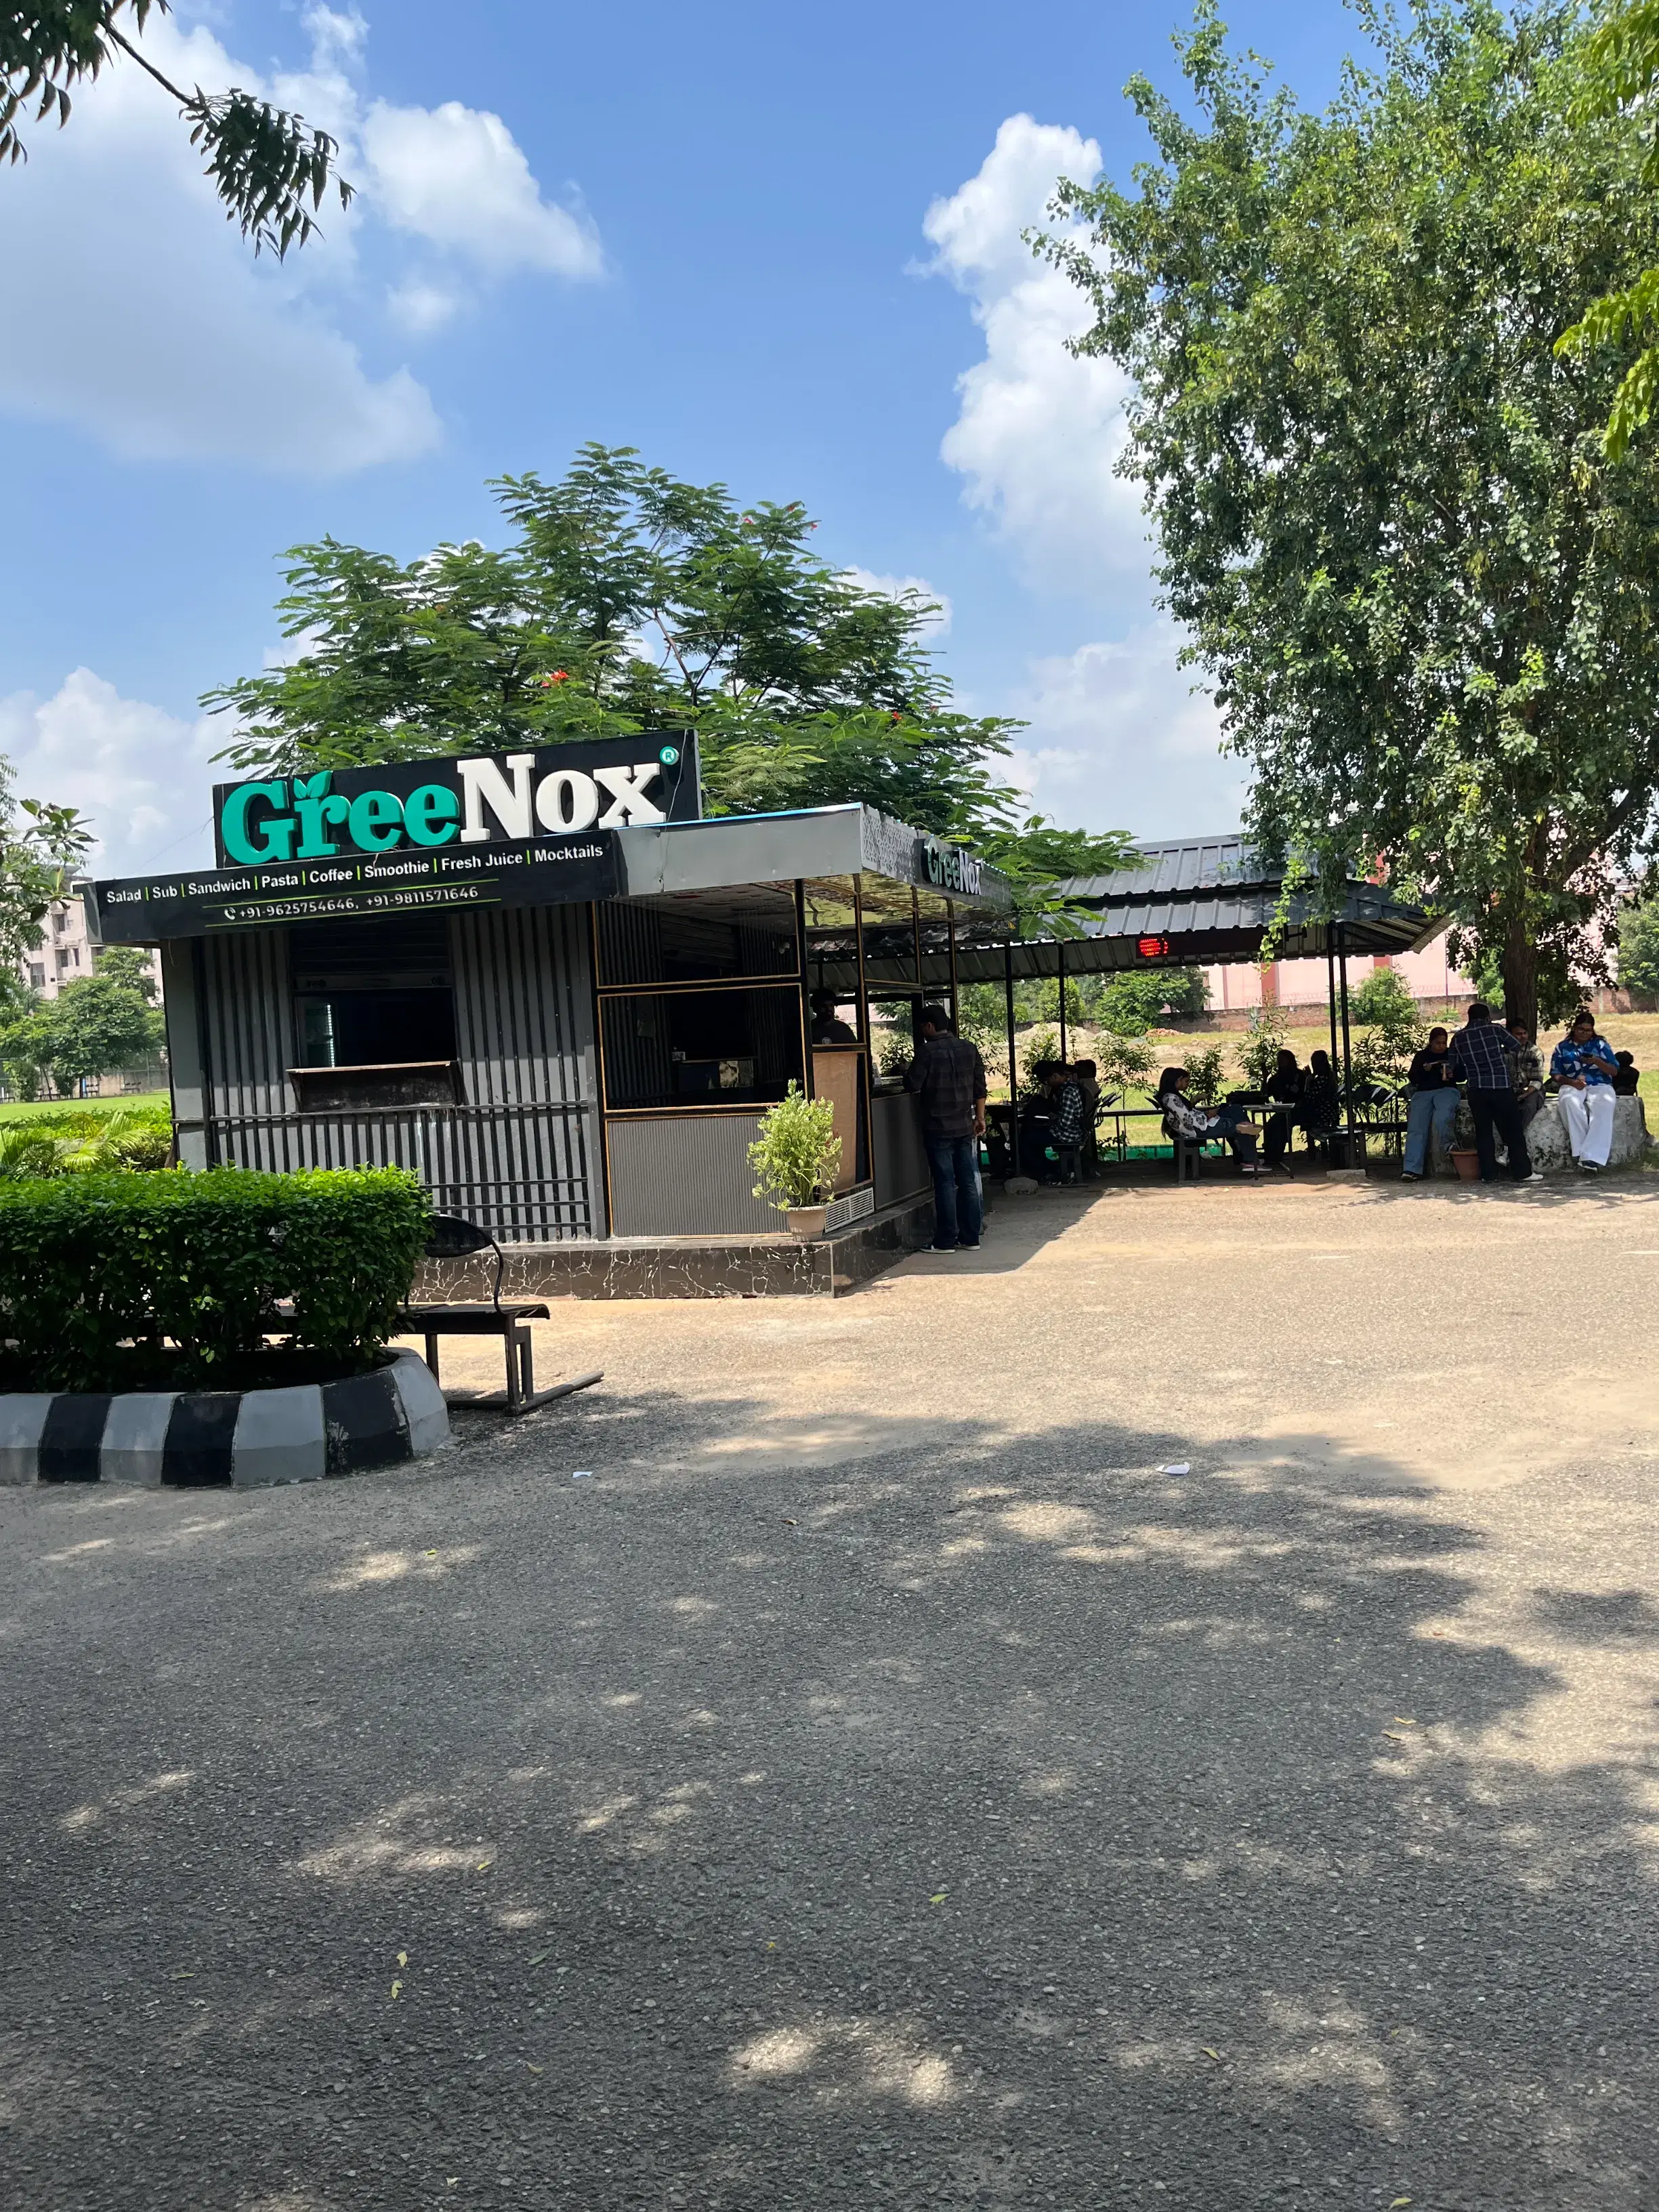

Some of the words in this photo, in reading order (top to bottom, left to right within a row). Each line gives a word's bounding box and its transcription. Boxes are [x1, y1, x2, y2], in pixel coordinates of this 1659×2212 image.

[222, 753, 667, 865] GreeNox
[107, 889, 142, 904] Salad
[152, 885, 177, 899] Sub
[188, 879, 251, 896] Sandwich
[261, 875, 299, 888] Pasta
[310, 869, 353, 883] Coffee
[364, 860, 429, 879] Smoothie
[442, 856, 481, 871] Fresh
[485, 852, 523, 867] Juice
[534, 844, 604, 862] Mocktails
[924, 835, 982, 895] GreeNox
[366, 886, 478, 907] +91-9811571646
